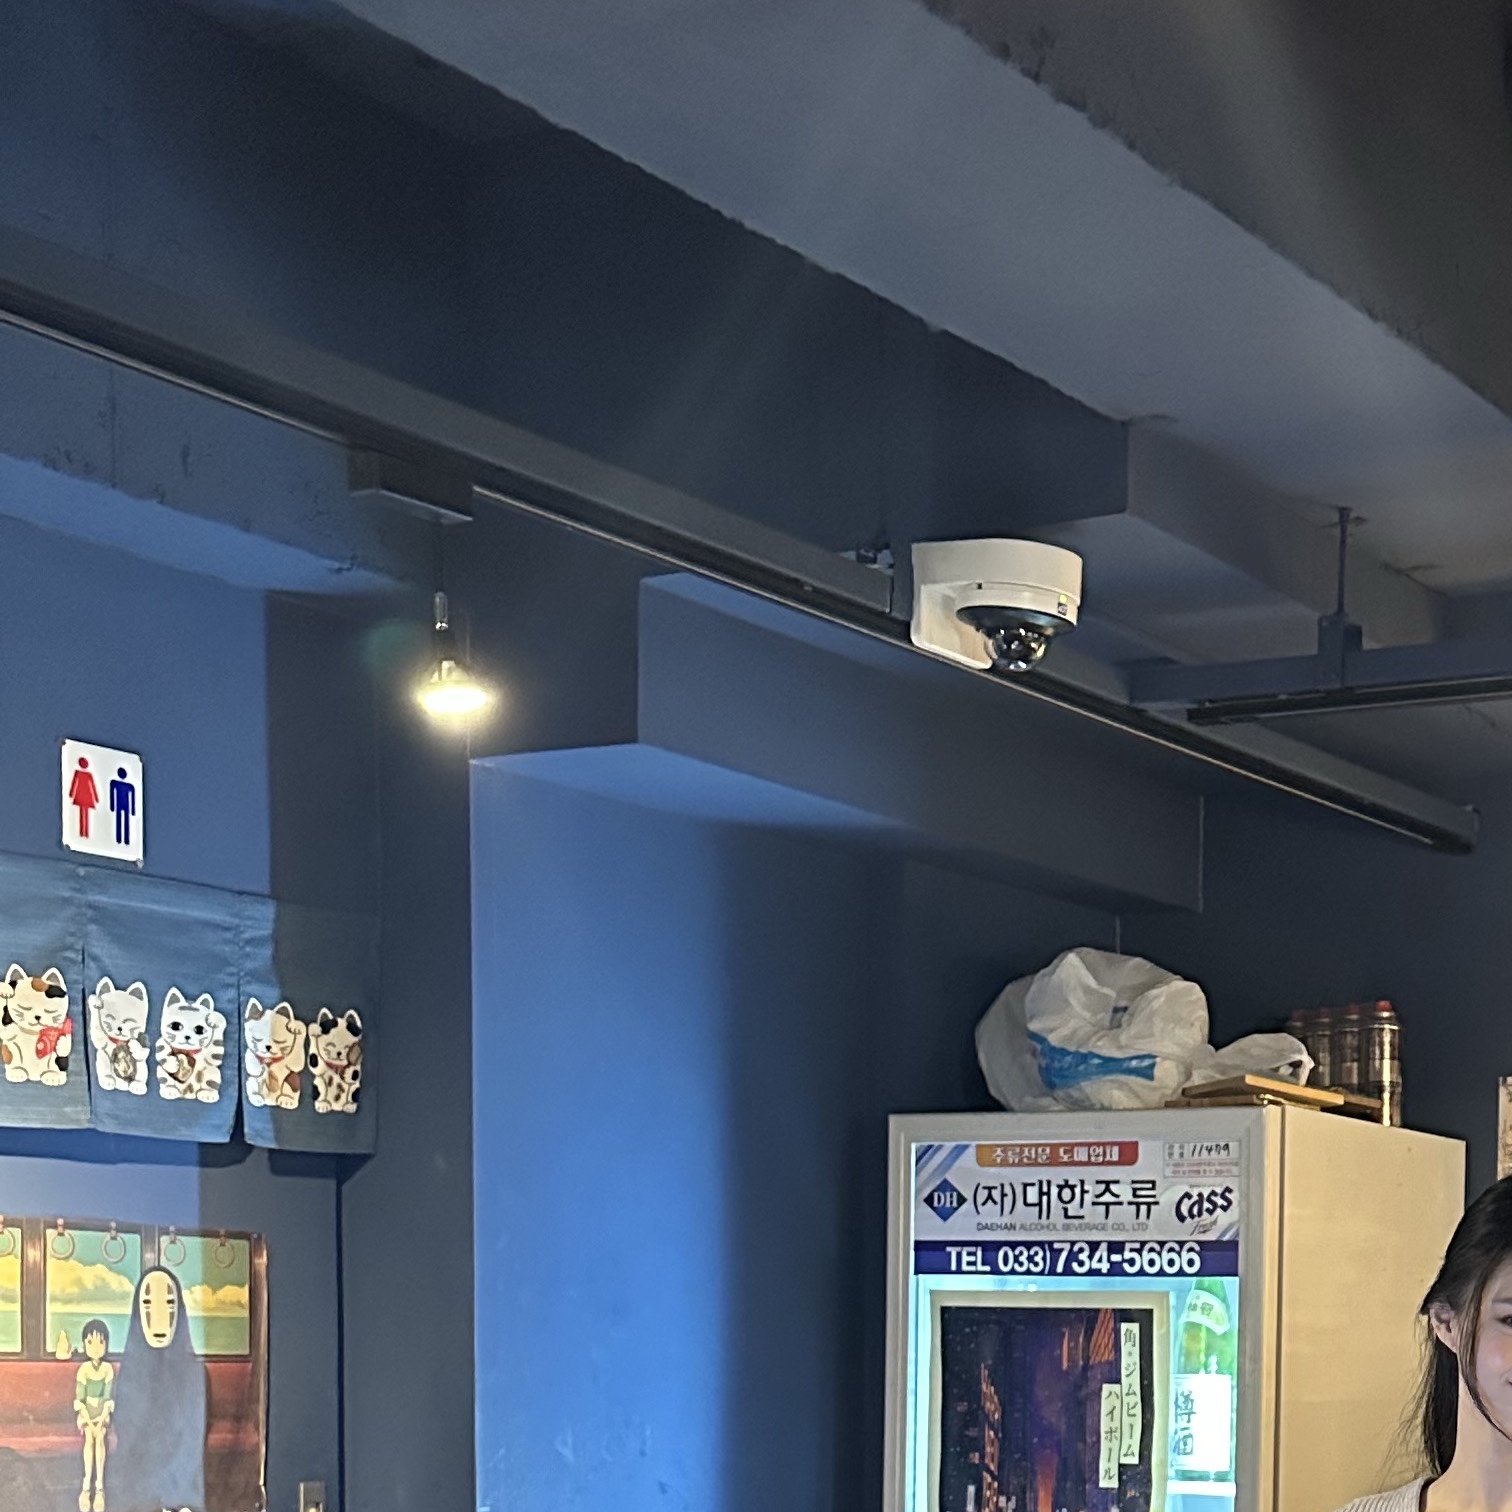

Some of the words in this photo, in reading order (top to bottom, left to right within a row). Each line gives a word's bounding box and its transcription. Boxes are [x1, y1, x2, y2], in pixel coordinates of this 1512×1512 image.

[992, 1144, 1051, 1164] 주류전문
[1058, 1144, 1119, 1162] 도매업체
[933, 1196, 959, 1208] DH
[973, 1178, 1160, 1221] (자)대한주류
[976, 1222, 1017, 1232] DAEHAN
[945, 1246, 991, 1272] TEL
